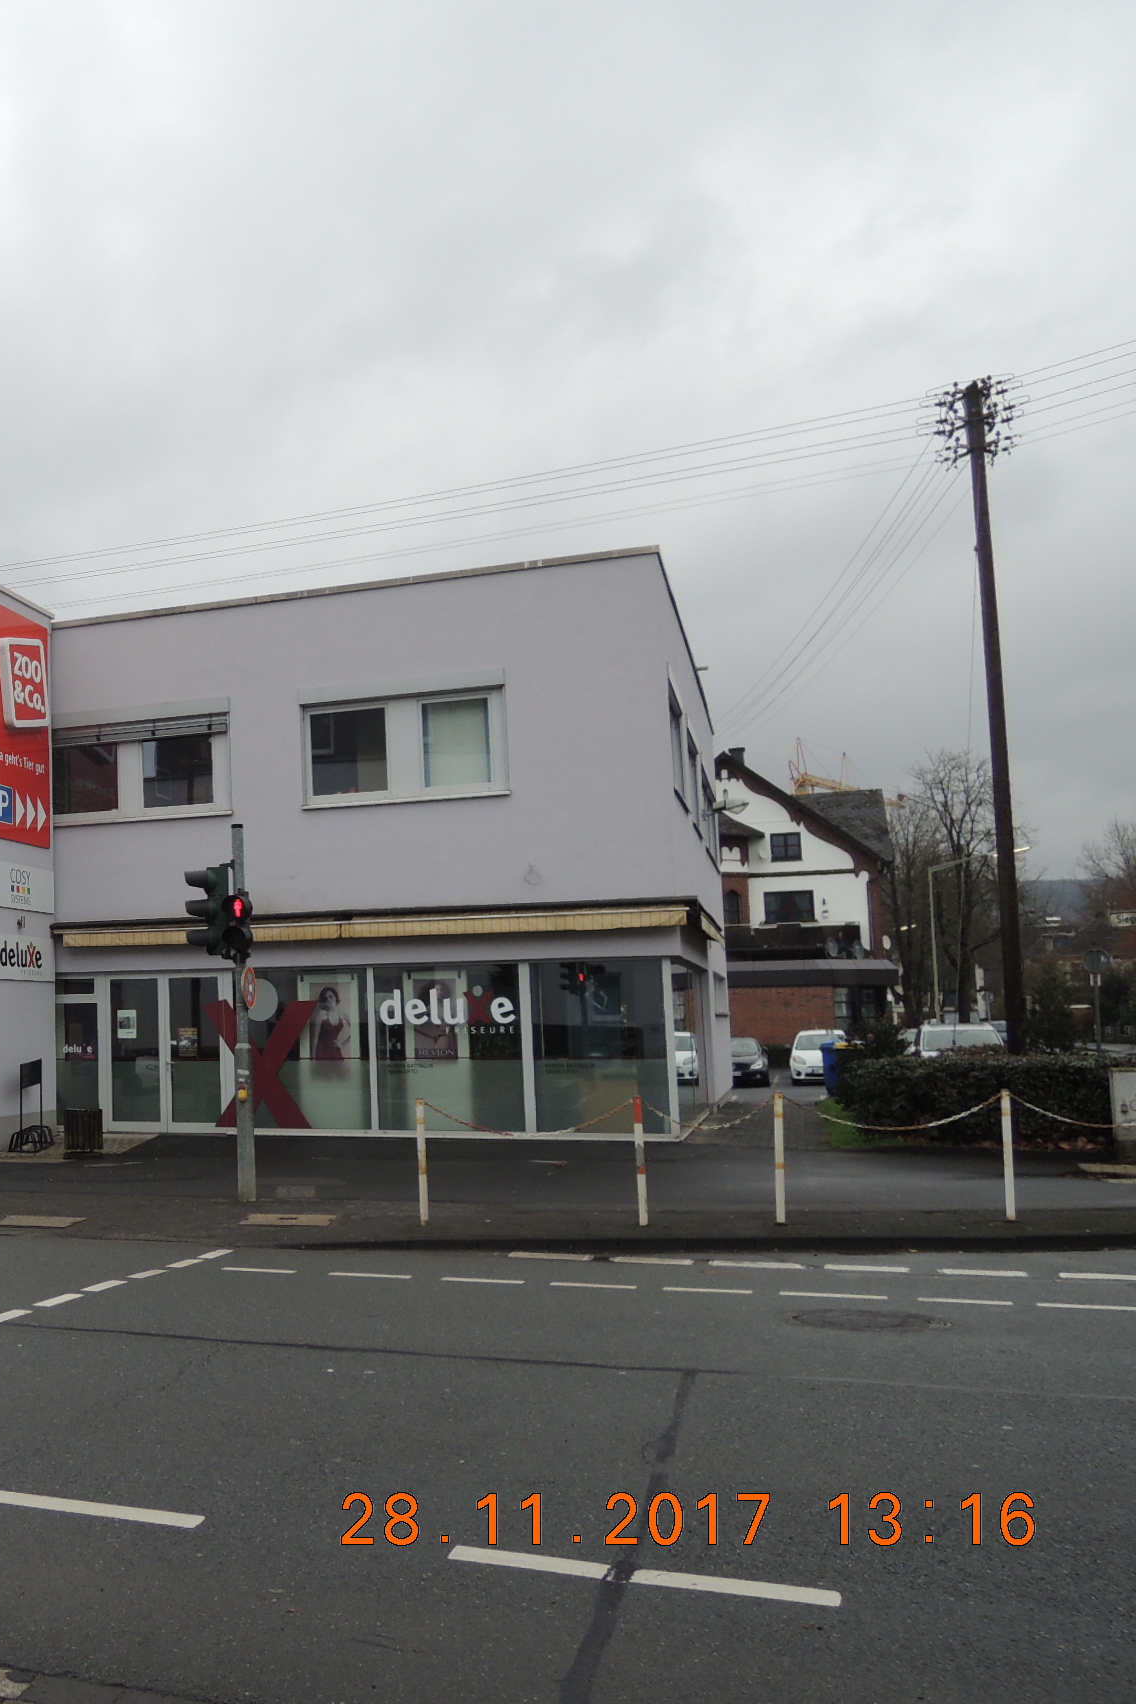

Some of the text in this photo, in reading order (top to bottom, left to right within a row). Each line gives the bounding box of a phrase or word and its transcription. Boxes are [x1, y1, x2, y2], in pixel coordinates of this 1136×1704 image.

[13, 651, 42, 684] ZOO
[14, 680, 45, 713] &Co.
[5, 752, 23, 767] geht's
[23, 757, 34, 771] Tier
[35, 763, 45, 775] gut
[0, 789, 10, 817] P
[10, 868, 31, 885] COSY
[10, 894, 31, 905] SYSTEME
[1116, 914, 1136, 924] Sieg
[445, 1026, 515, 1035] FRISEURE
[418, 1048, 455, 1056] REVLON
